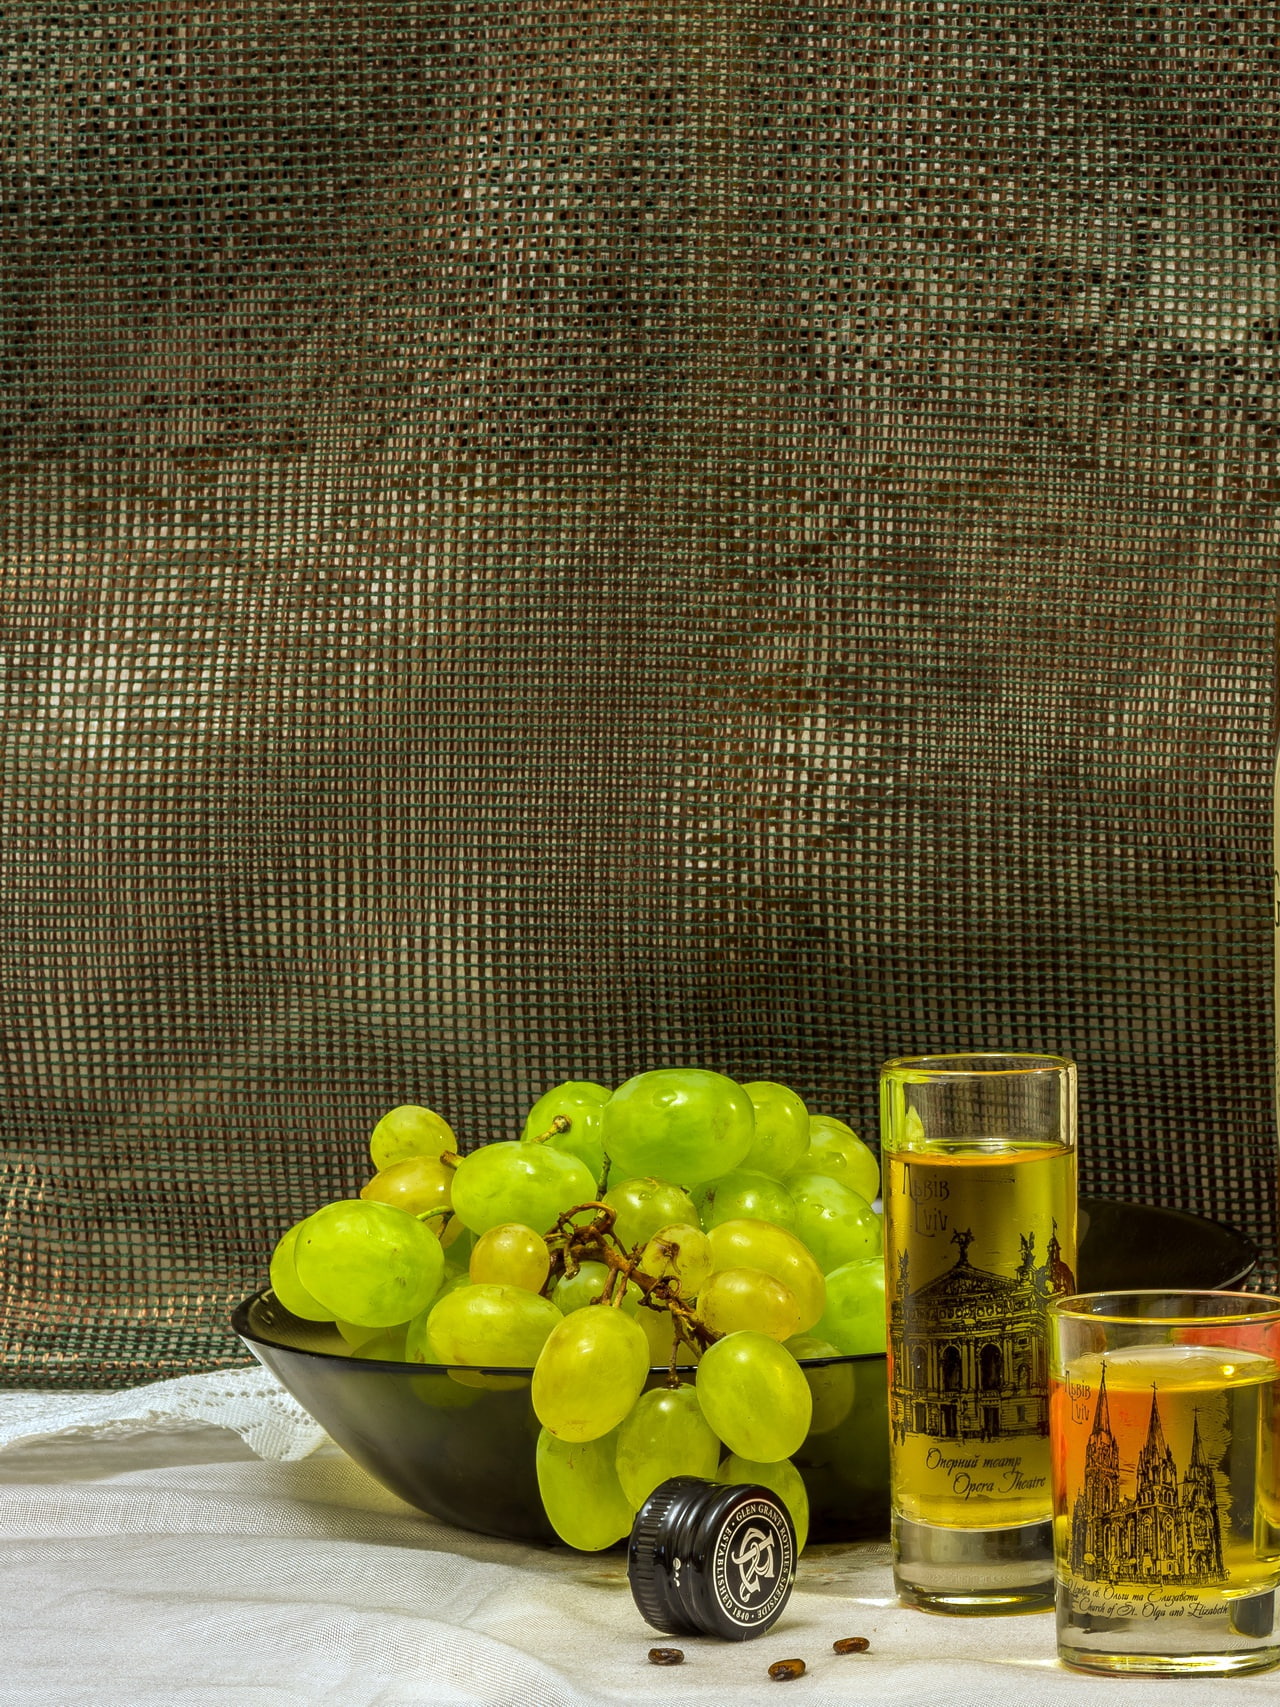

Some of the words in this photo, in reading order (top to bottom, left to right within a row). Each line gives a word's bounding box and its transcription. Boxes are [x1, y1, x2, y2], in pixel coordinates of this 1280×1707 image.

[926, 1447, 980, 1476] Оперний
[982, 1455, 1022, 1474] театр
[953, 1472, 995, 1500] Opera
[998, 1471, 1046, 1494] Theatre
[736, 1504, 756, 1521] GLEN
[758, 1505, 782, 1527] GRANT
[779, 1528, 791, 1574] ROTHES
[716, 1527, 733, 1610] ESTABLISHED
[732, 1607, 750, 1621] 1840
[1079, 1597, 1106, 1613] Church
[1107, 1602, 1118, 1618] of
[1141, 1602, 1166, 1621] Olga
[1169, 1606, 1184, 1617] and
[1187, 1602, 1228, 1617] Elizabeth
